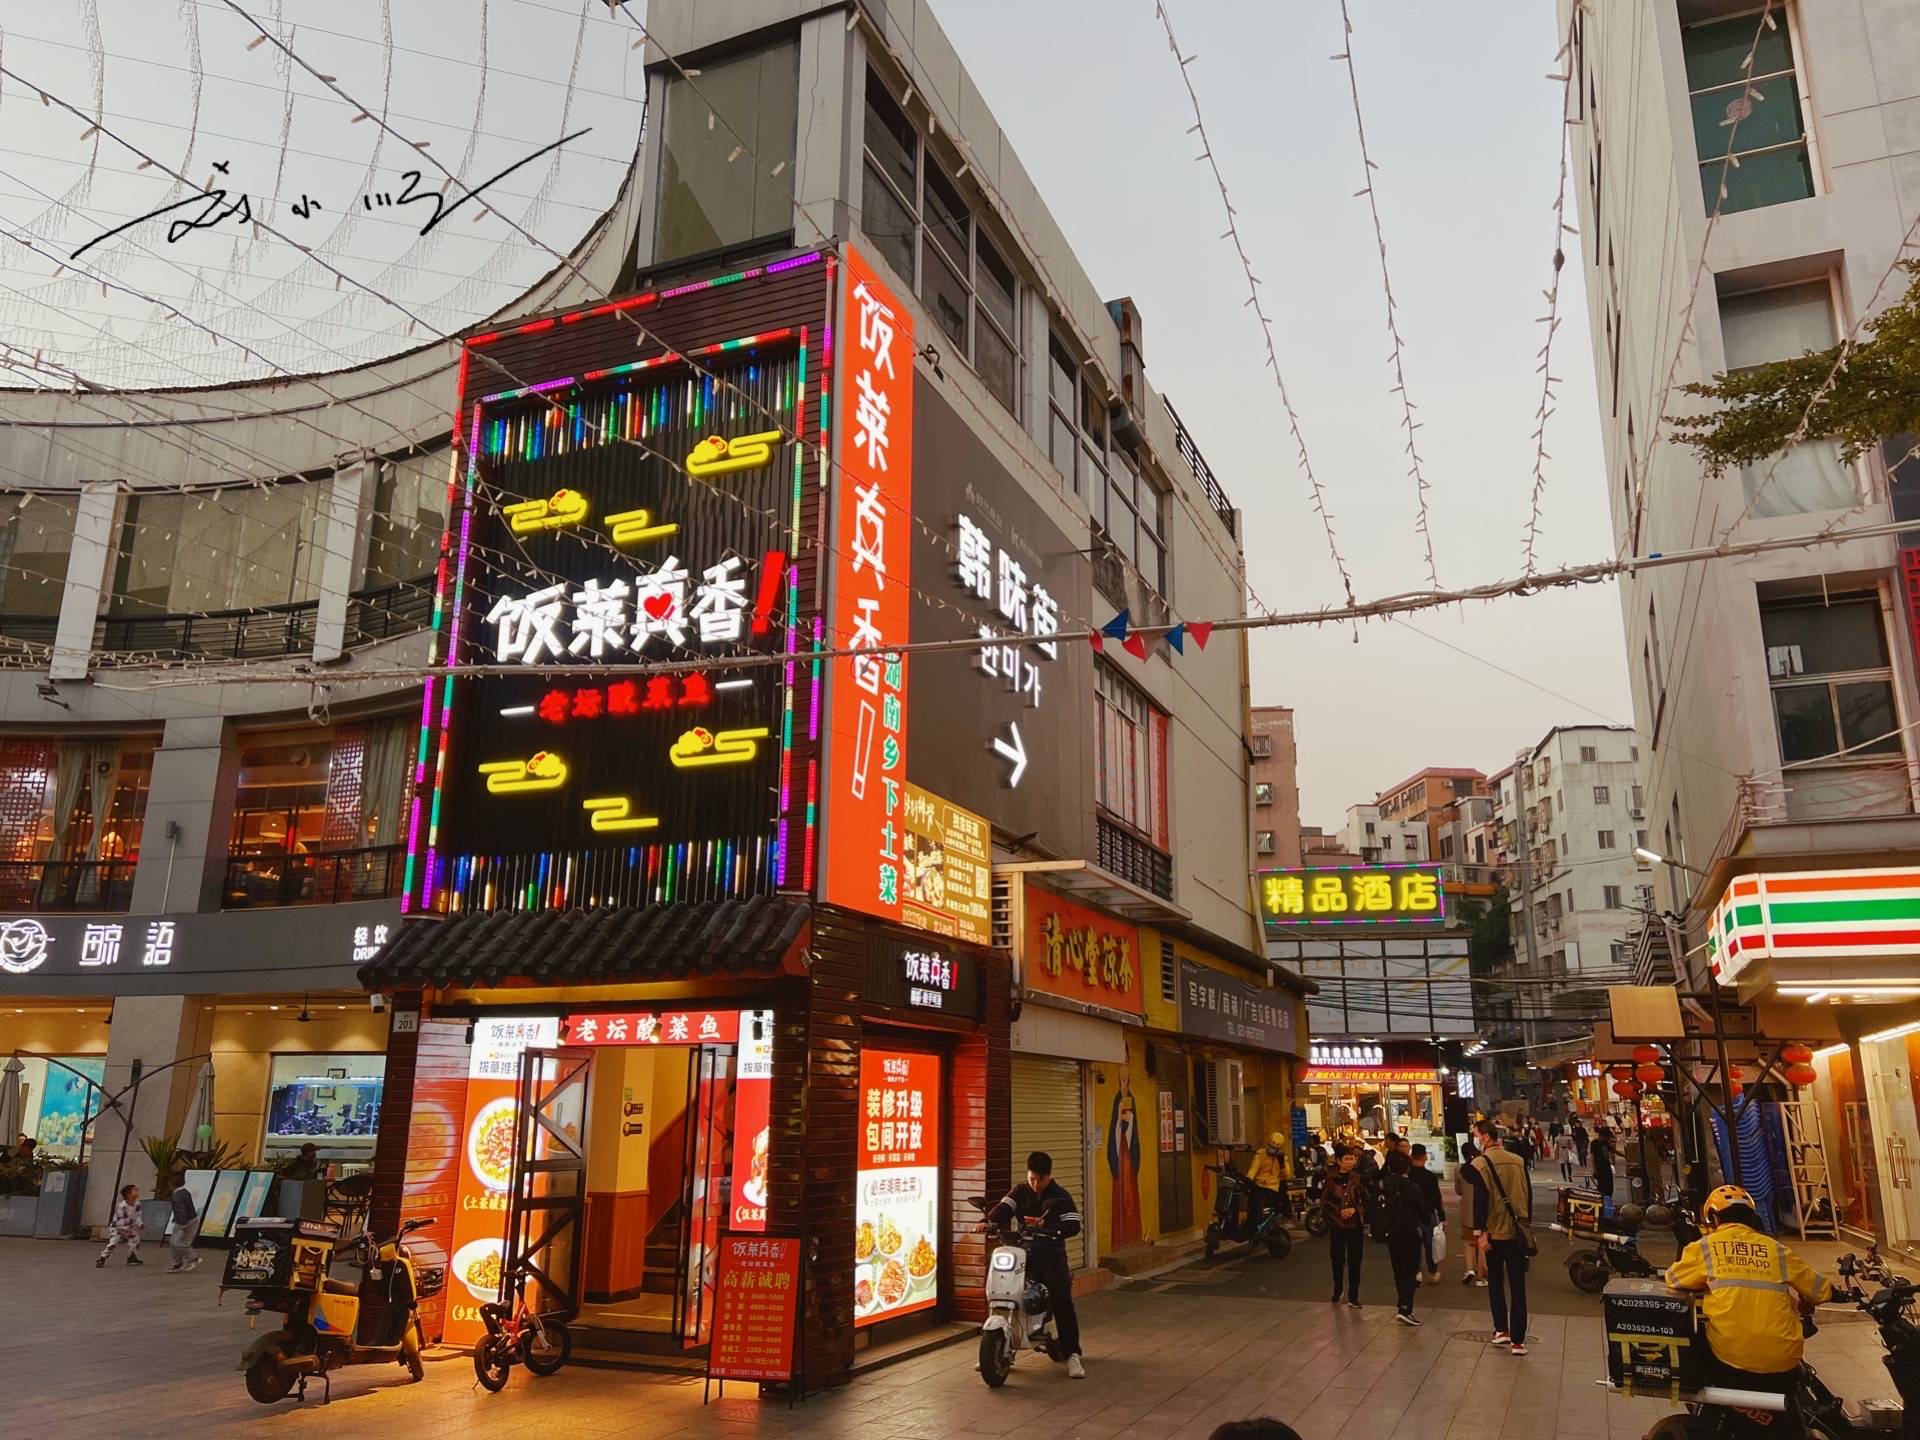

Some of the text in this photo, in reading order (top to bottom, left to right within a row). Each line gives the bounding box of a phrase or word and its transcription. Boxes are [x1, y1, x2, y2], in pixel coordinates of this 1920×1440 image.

[487, 552, 786, 664] 饭菜真香!
[1265, 873, 1437, 914] 精品酒店
[354, 924, 388, 946] 轻饮
[398, 1020, 413, 1030] 201
[576, 1014, 721, 1041] 老坛酸菜鱼
[867, 1088, 923, 1118] 装修升级
[866, 1121, 923, 1151] 包间开放
[1712, 1241, 1769, 1258] 订酒店
[1715, 1256, 1771, 1270] 上美团App
[723, 1270, 791, 1291] 高薪诚聘
